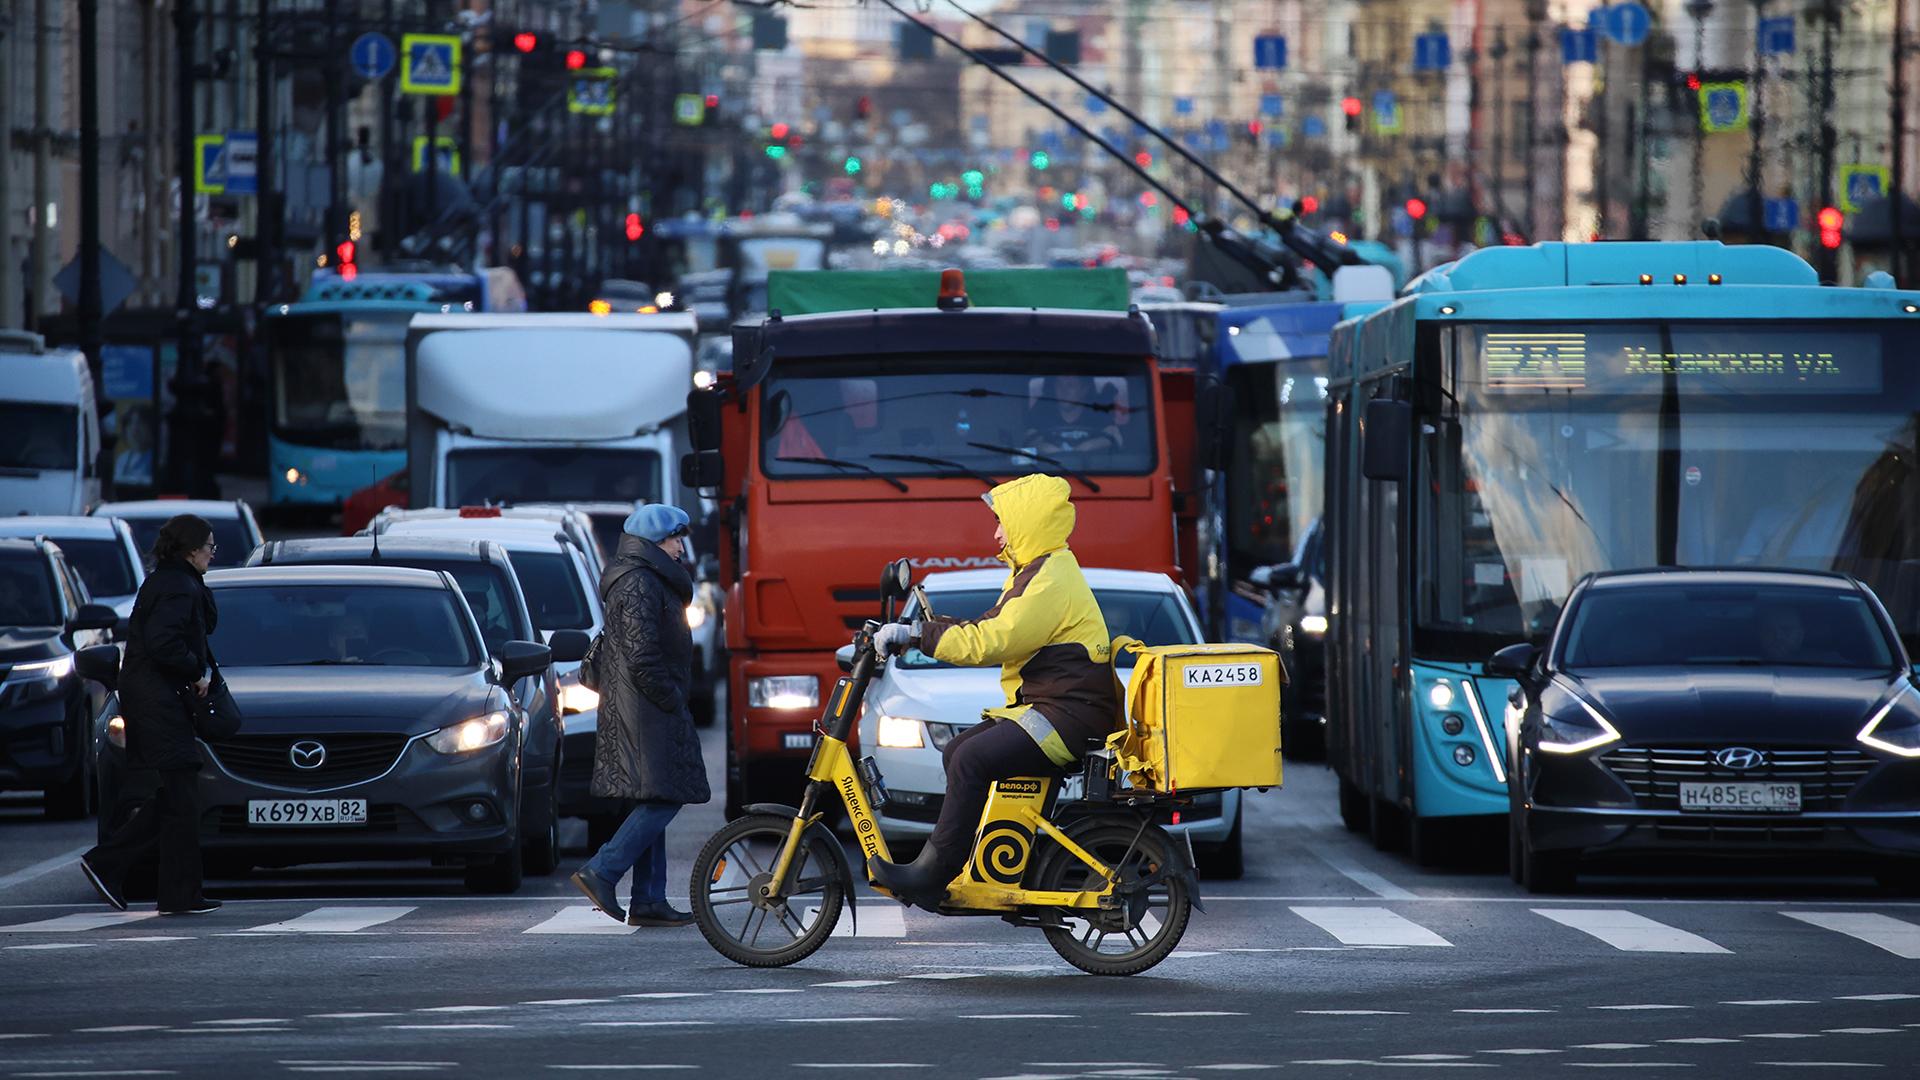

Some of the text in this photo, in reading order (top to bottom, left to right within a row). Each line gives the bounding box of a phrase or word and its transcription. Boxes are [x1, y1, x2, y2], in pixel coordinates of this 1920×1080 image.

[999, 782, 1038, 792] вело.рф
[1686, 786, 1796, 805] Н485ЕС 198
[255, 801, 361, 822] К699ХВ 82
[841, 776, 879, 857] Яндекс Еда
